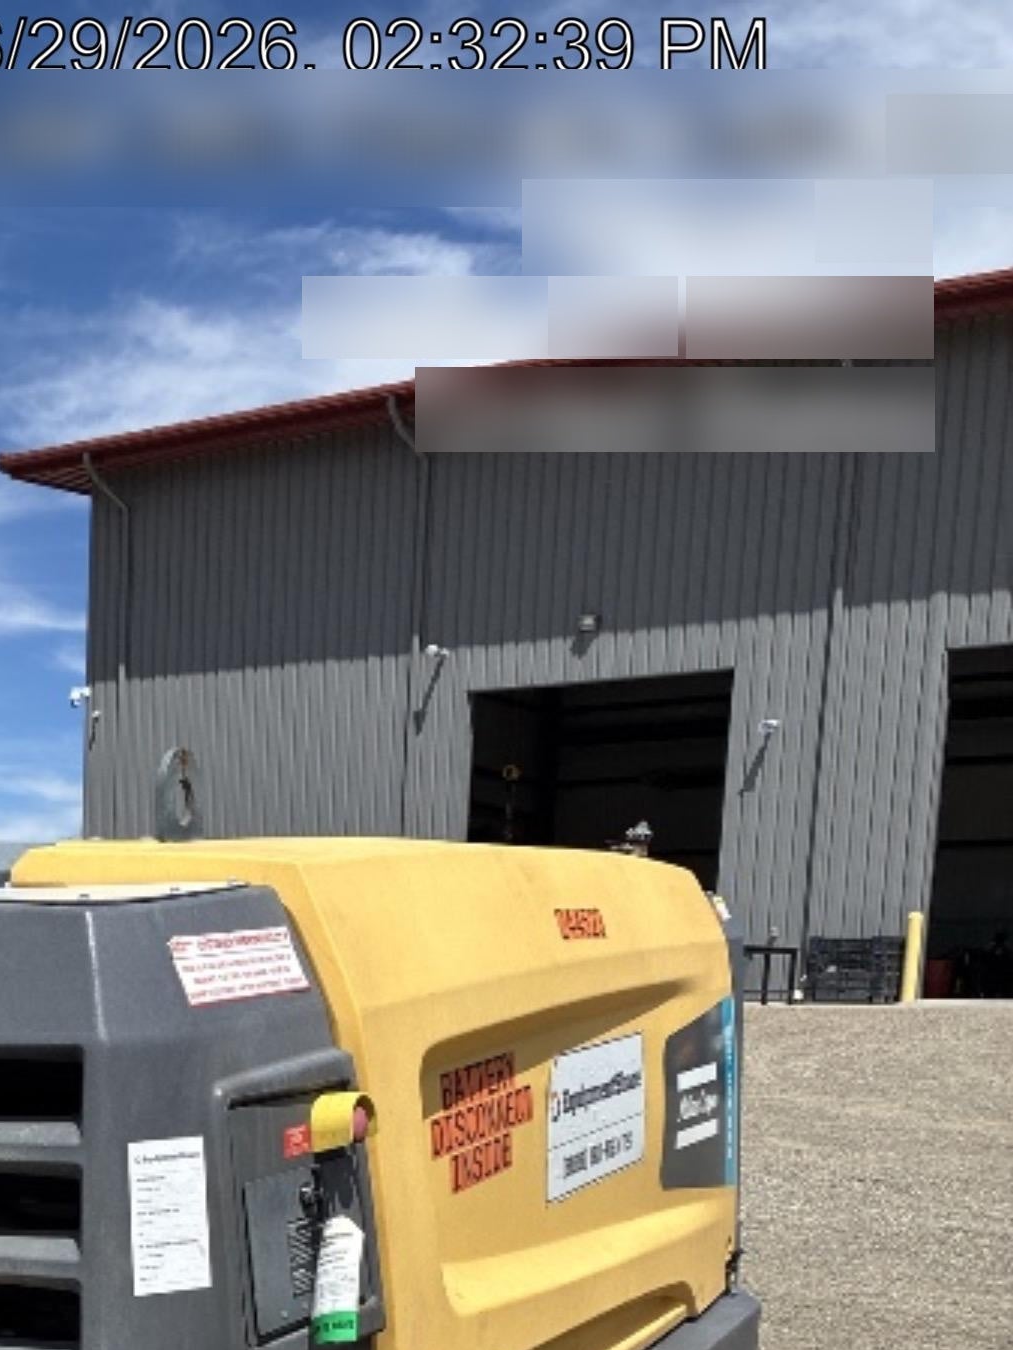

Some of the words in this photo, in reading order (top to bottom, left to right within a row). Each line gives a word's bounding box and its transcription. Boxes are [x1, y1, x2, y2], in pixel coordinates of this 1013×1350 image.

[440, 1050, 515, 1111] BATTERY
[430, 1084, 533, 1157] DISCONNECT
[451, 1132, 513, 1193] INSIDE
